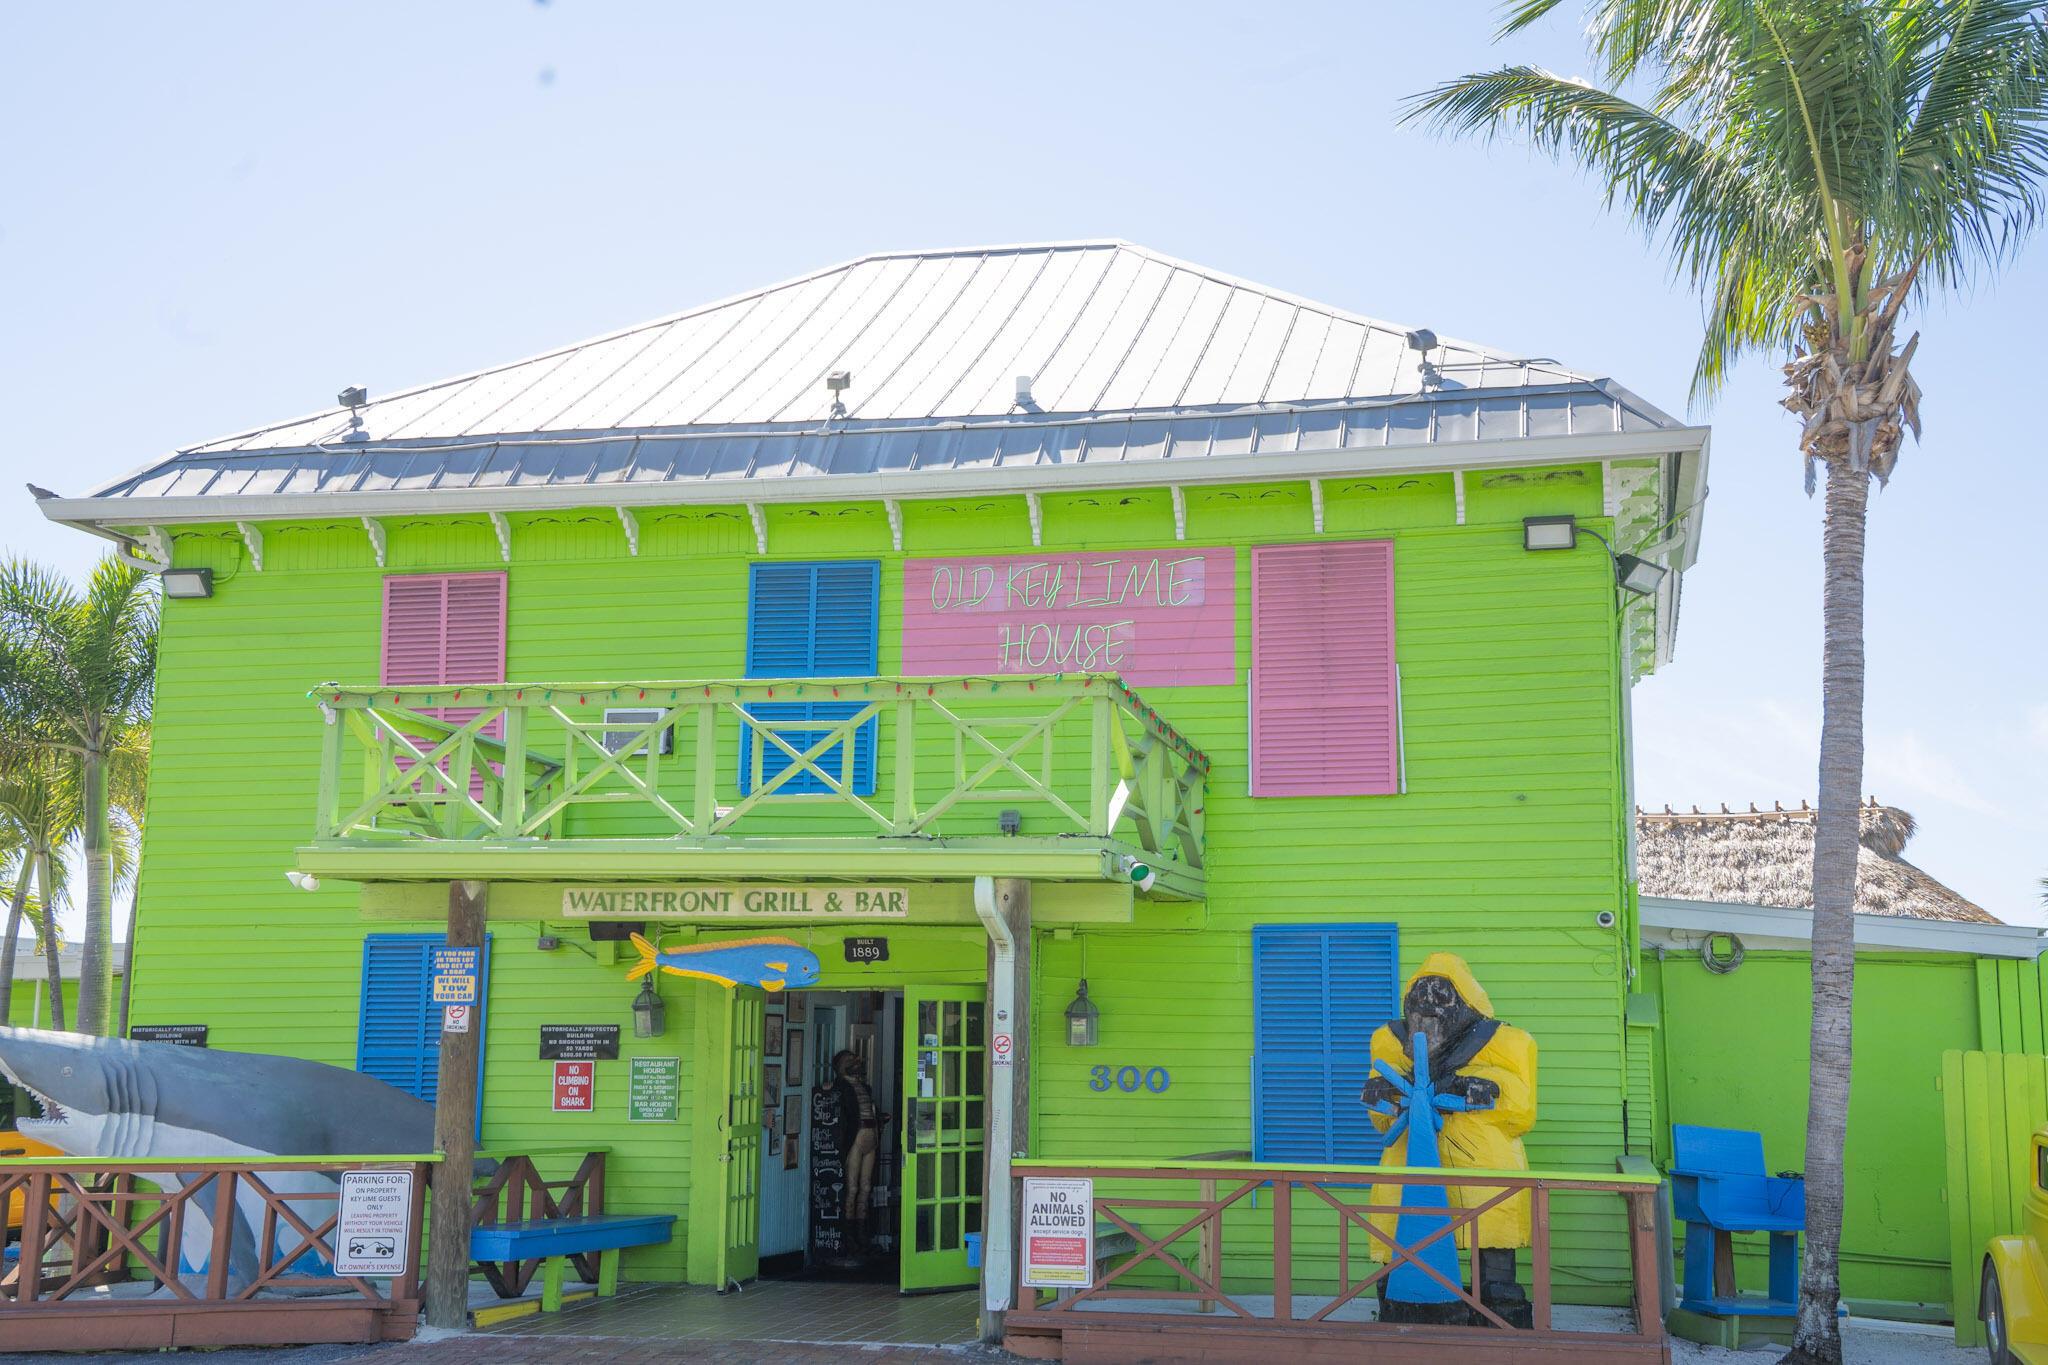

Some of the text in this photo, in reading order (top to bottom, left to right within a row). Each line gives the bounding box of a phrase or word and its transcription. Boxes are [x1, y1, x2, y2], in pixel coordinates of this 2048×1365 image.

[931, 556, 1206, 610] OLD KEY LIME
[999, 620, 1135, 670] HOUSE
[568, 891, 904, 912] WATERFRONT GRILL & BAR
[853, 947, 880, 960] 1889
[569, 1065, 580, 1074] NO
[558, 1076, 589, 1085] CLIMBING
[1089, 1065, 1171, 1094] 300
[568, 1086, 579, 1096] ON
[561, 1096, 586, 1106] SHARK
[346, 1176, 406, 1185] PARKING FOR:
[1050, 1191, 1067, 1203] NO
[1032, 1204, 1084, 1215] ANIMALS
[1030, 1215, 1086, 1227] ALLOWED
